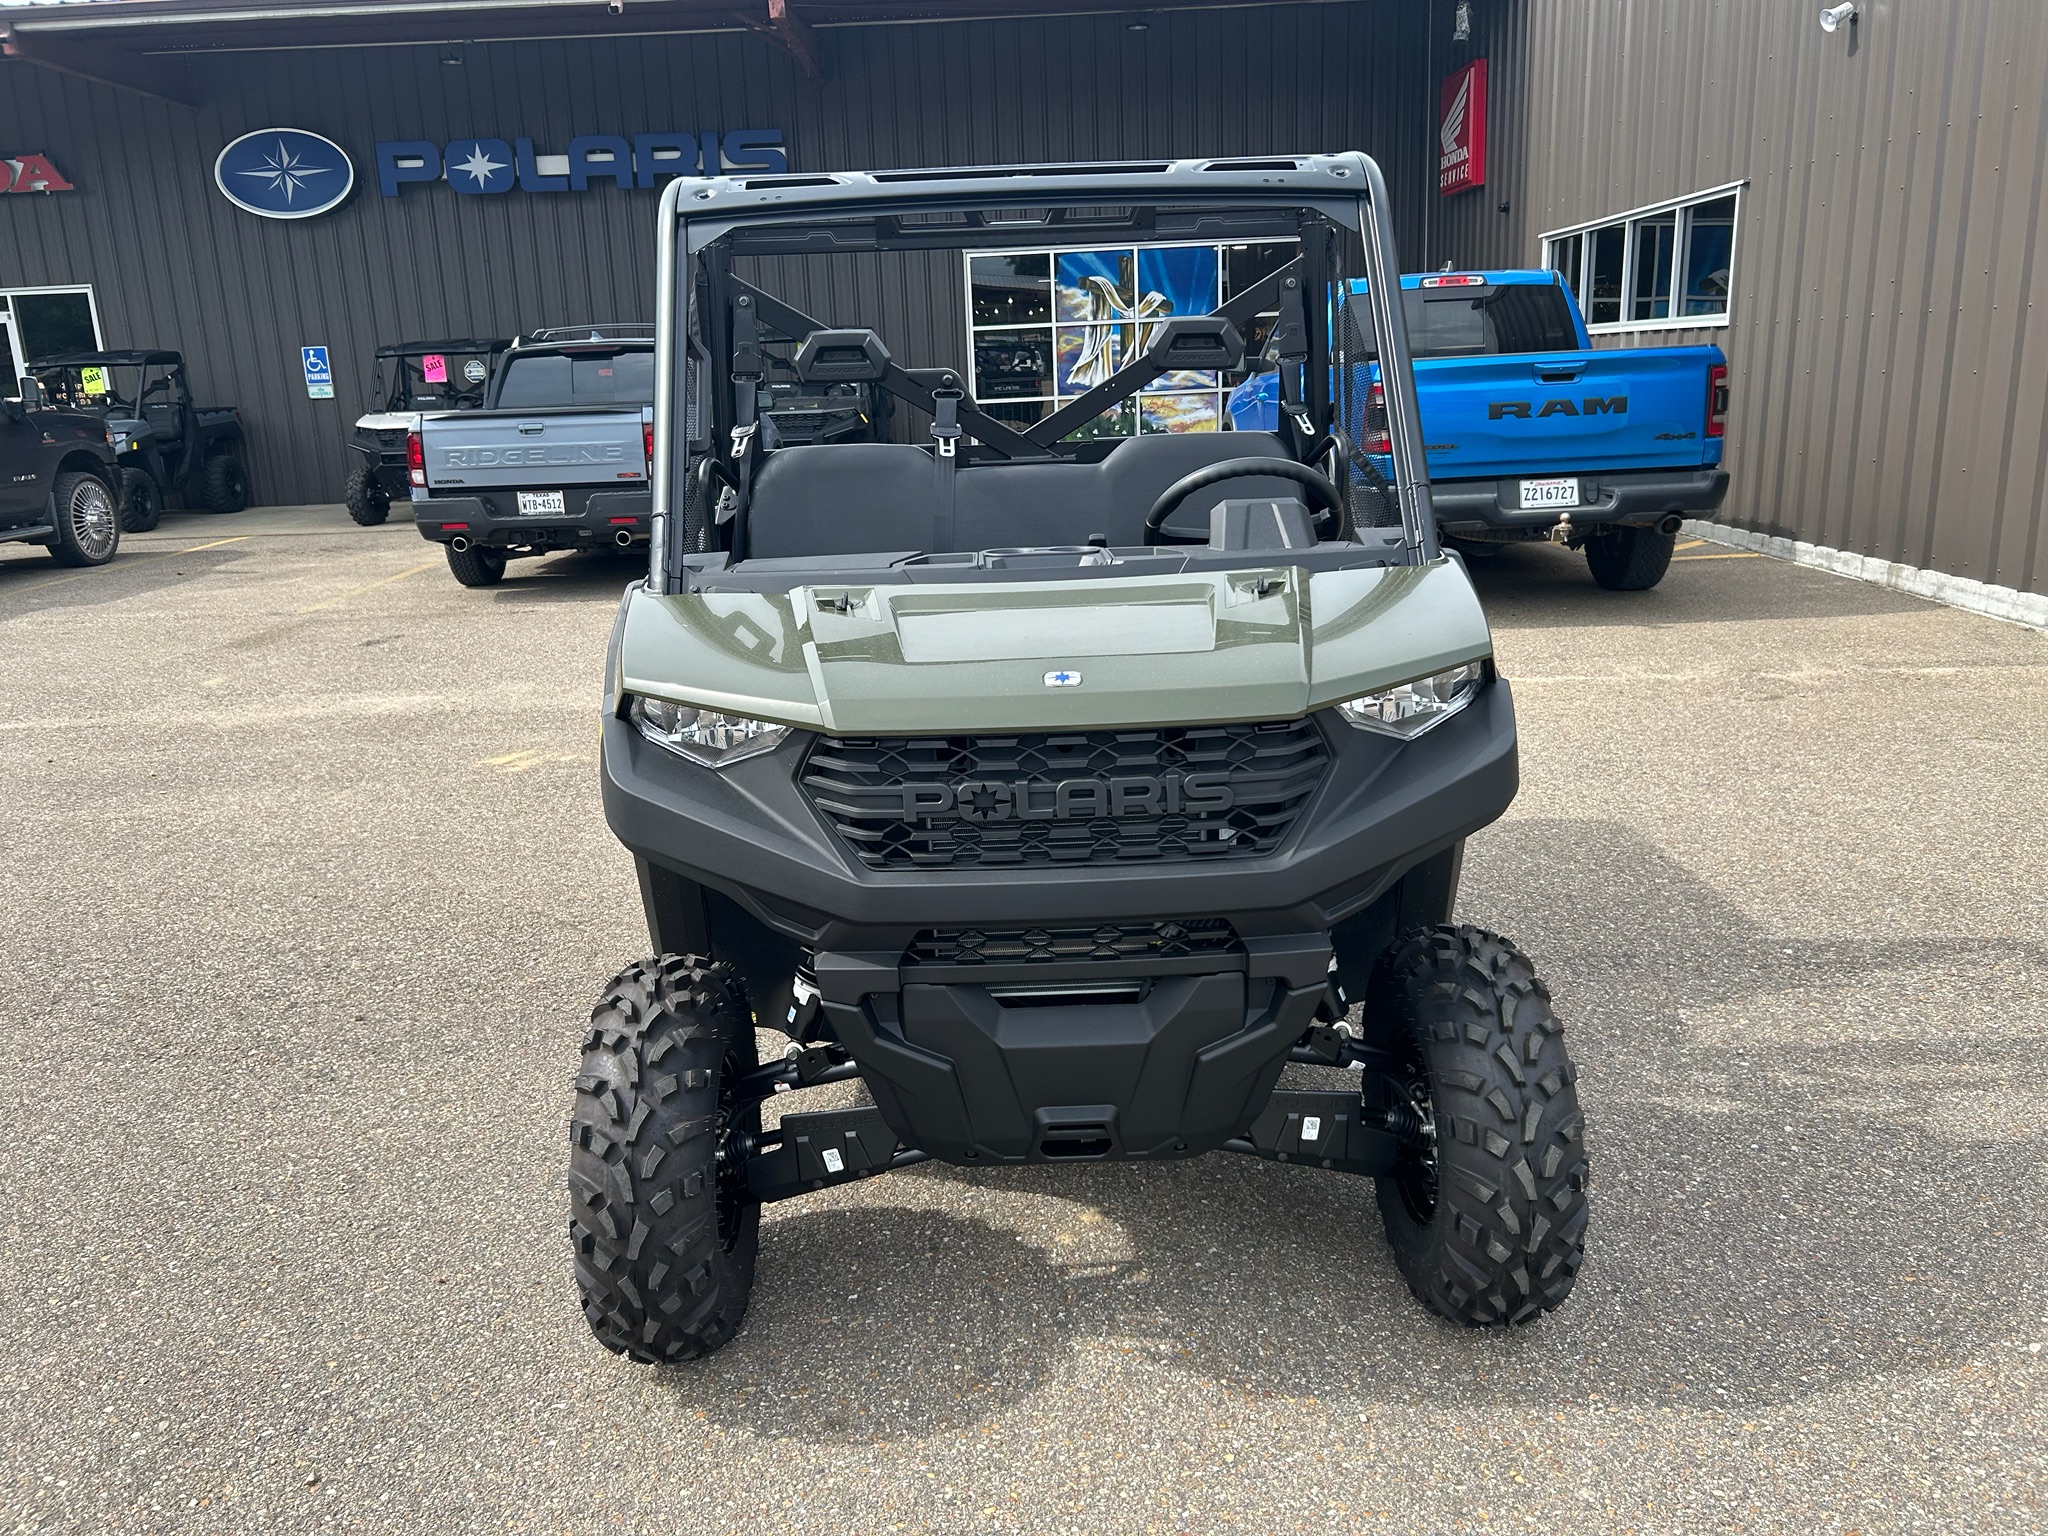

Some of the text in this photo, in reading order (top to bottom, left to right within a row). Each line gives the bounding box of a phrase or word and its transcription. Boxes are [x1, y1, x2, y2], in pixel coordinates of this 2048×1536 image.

[375, 129, 788, 197] POLARIS
[1440, 145, 1469, 170] HONDA
[1440, 163, 1469, 188] SERVICE
[425, 359, 443, 372] SALE
[816, 366, 870, 375] RANGER
[84, 371, 102, 385] SALE
[308, 372, 329, 380] PARKING
[1488, 396, 1628, 420] RAM
[1653, 430, 1696, 441] 4x4
[446, 447, 624, 467] RIDGELINE
[1523, 485, 1575, 501] Z216727
[902, 771, 1234, 822] POLARIS
